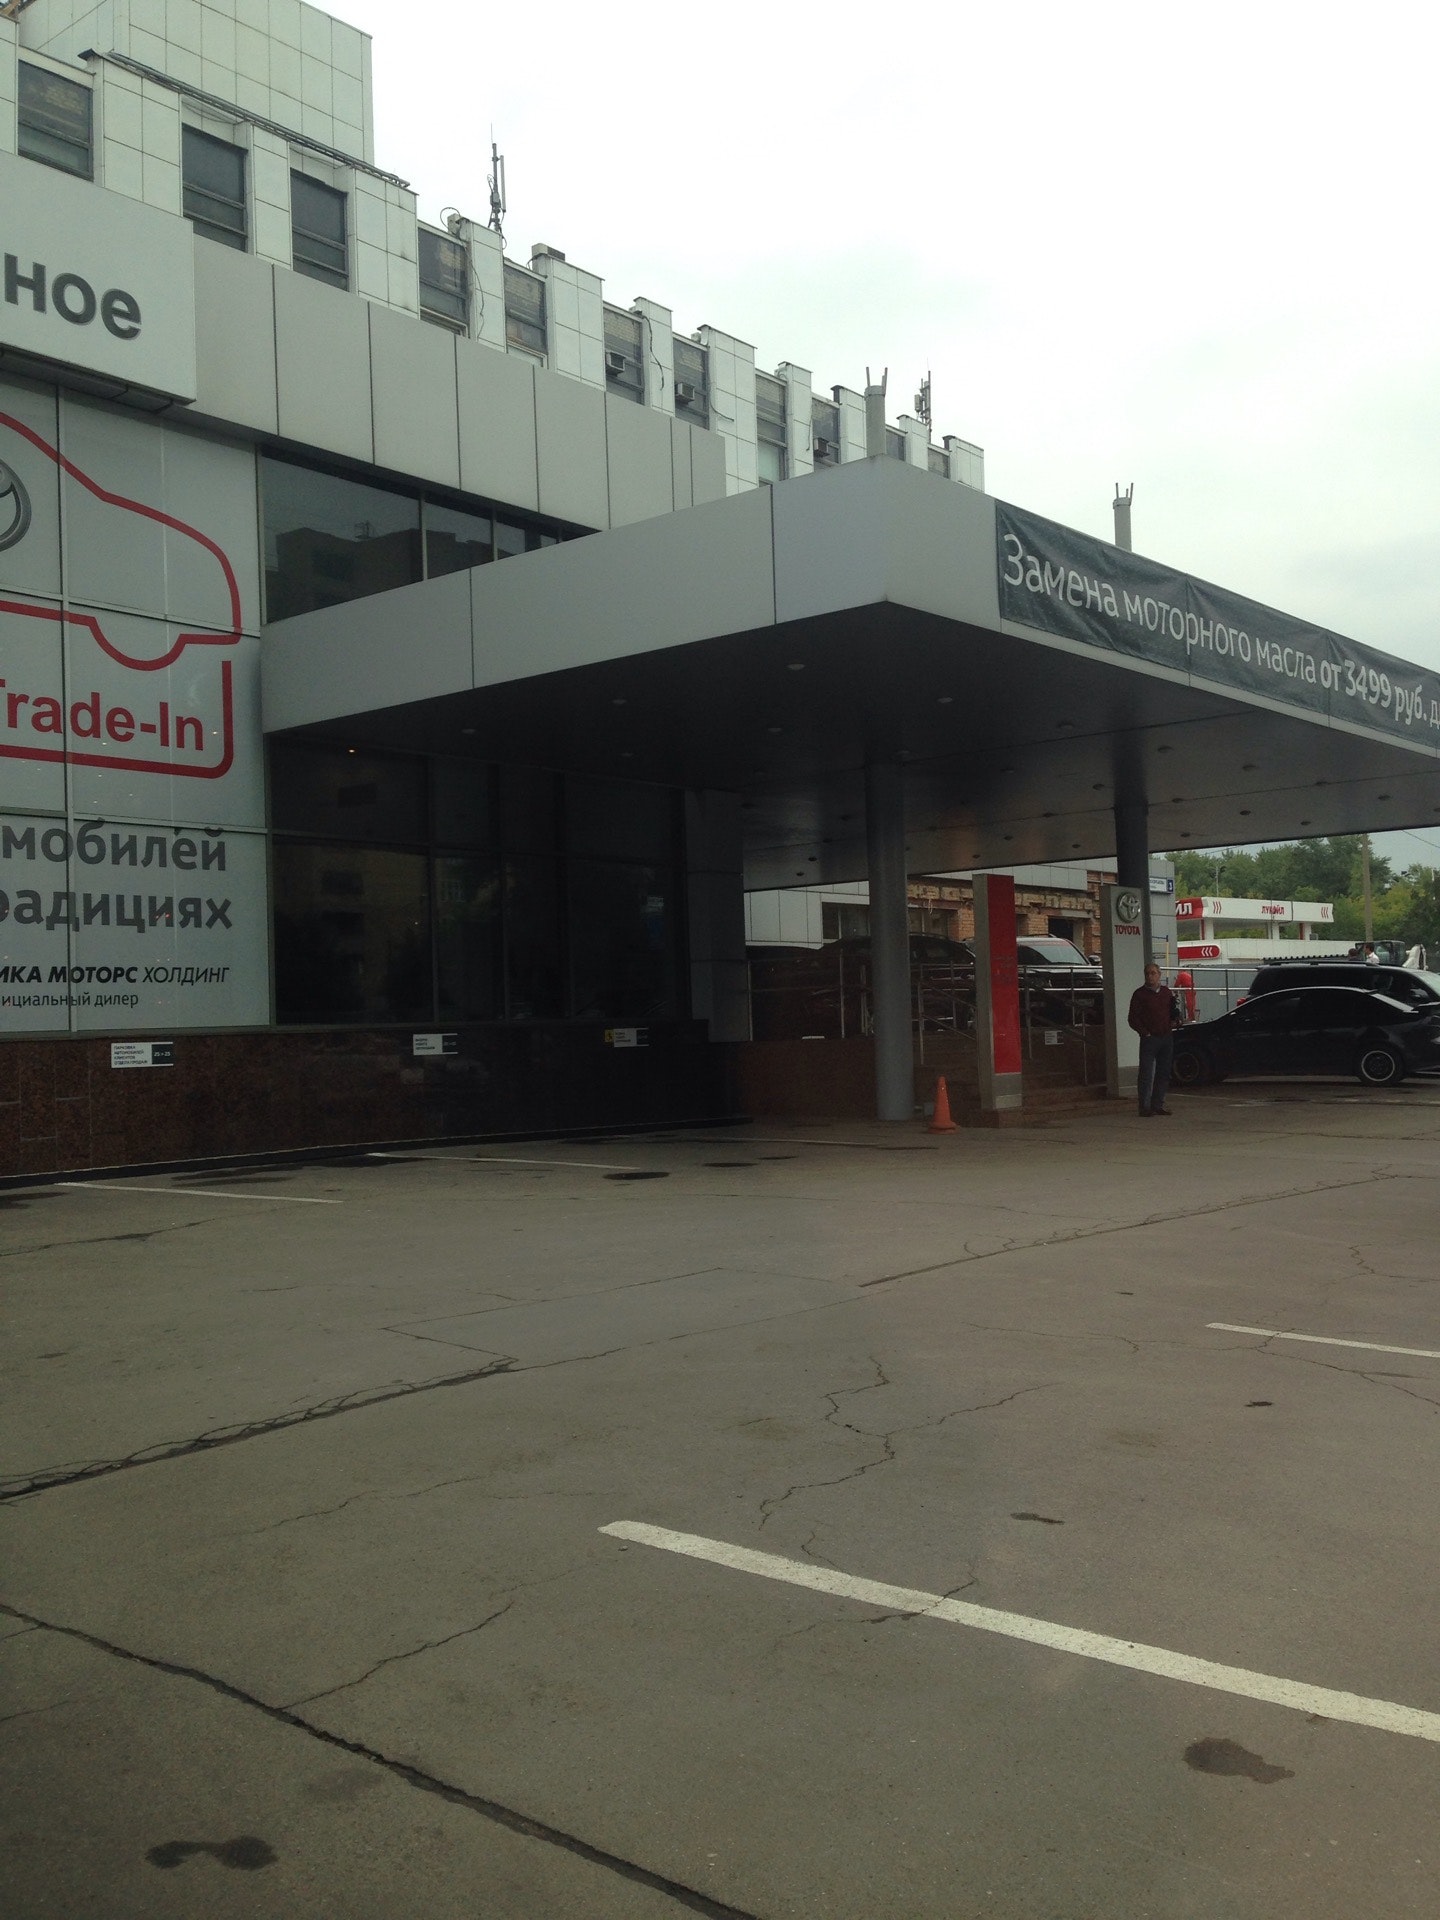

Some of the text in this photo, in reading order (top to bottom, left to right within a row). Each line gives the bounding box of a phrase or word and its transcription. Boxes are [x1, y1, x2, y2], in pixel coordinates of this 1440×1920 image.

[4, 252, 142, 341] ное
[1003, 533, 1120, 618] Замена
[1123, 590, 1251, 663] моторного
[1256, 637, 1317, 684] масла
[1320, 660, 1342, 692] от
[1344, 659, 1392, 708] 3499
[1394, 684, 1427, 725] руб.
[0, 678, 204, 751] rade-In
[2, 817, 226, 871] мобилей
[1114, 925, 1141, 936] TOYOTA
[2, 991, 139, 1009] ициальный дилер
[47, 966, 139, 984] МОТОРС
[142, 966, 230, 986] ХОЛДИНГ
